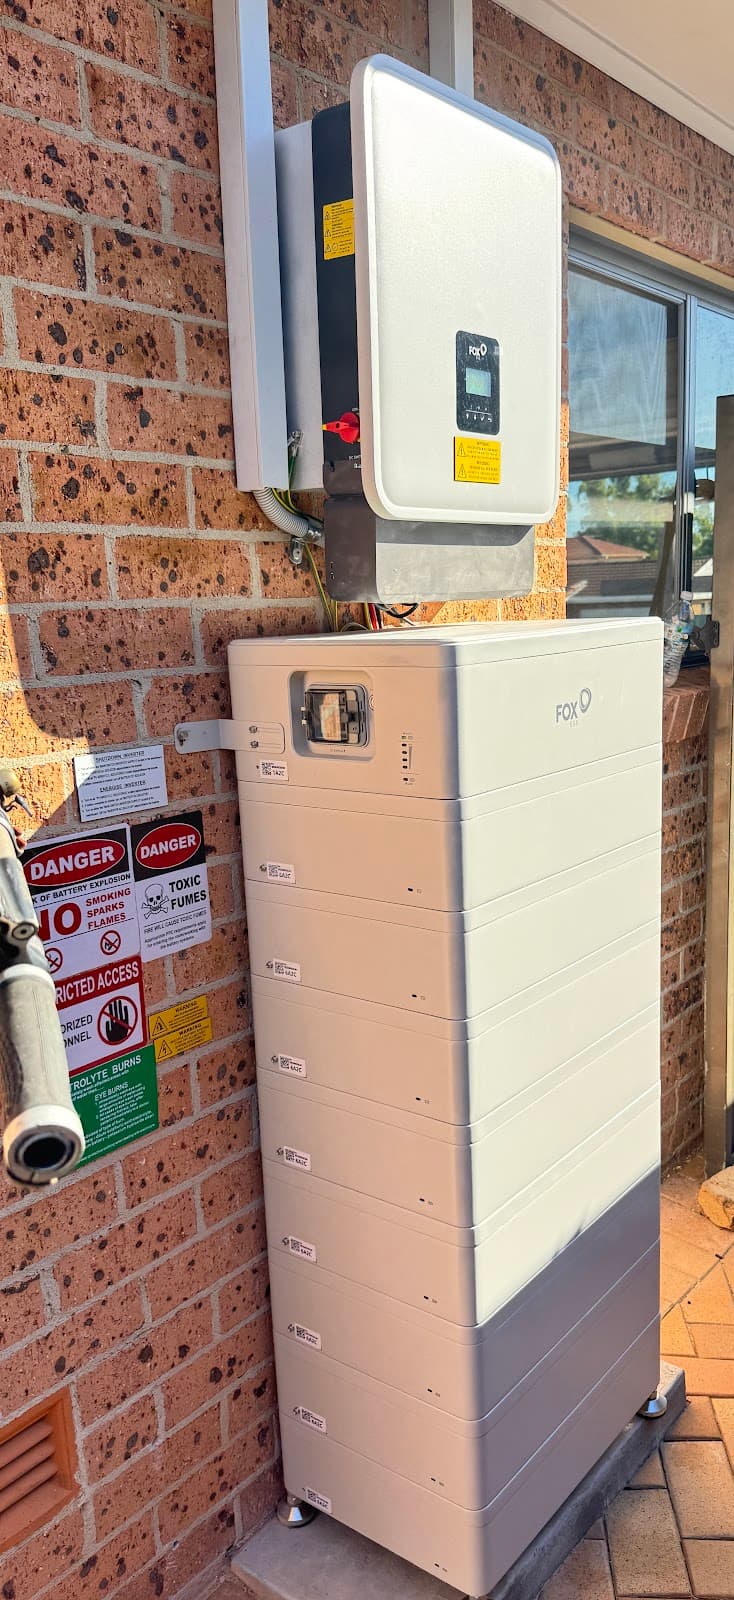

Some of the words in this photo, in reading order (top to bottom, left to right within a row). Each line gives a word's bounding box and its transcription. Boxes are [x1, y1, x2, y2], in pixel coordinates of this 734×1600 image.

[556, 701, 578, 723] FOX
[141, 834, 196, 859] DANGER
[30, 846, 115, 880] DANGER
[40, 894, 51, 902] OF
[53, 885, 88, 899] BATTERY
[89, 873, 131, 889] EXPLOSION
[169, 875, 201, 892] TOXIC
[86, 888, 131, 907] SMOKING
[171, 890, 207, 910] FUMES
[87, 901, 125, 918] SPARKS
[88, 912, 126, 930] FLAMES
[56, 976, 95, 1004] RICTED
[97, 961, 139, 990] ACCESS
[60, 1014, 93, 1034] ORIZED
[71, 1068, 109, 1091] ROLYTE
[112, 1054, 142, 1074] BURNS
[94, 1089, 107, 1101] EYE
[107, 1080, 128, 1096] BURNS
